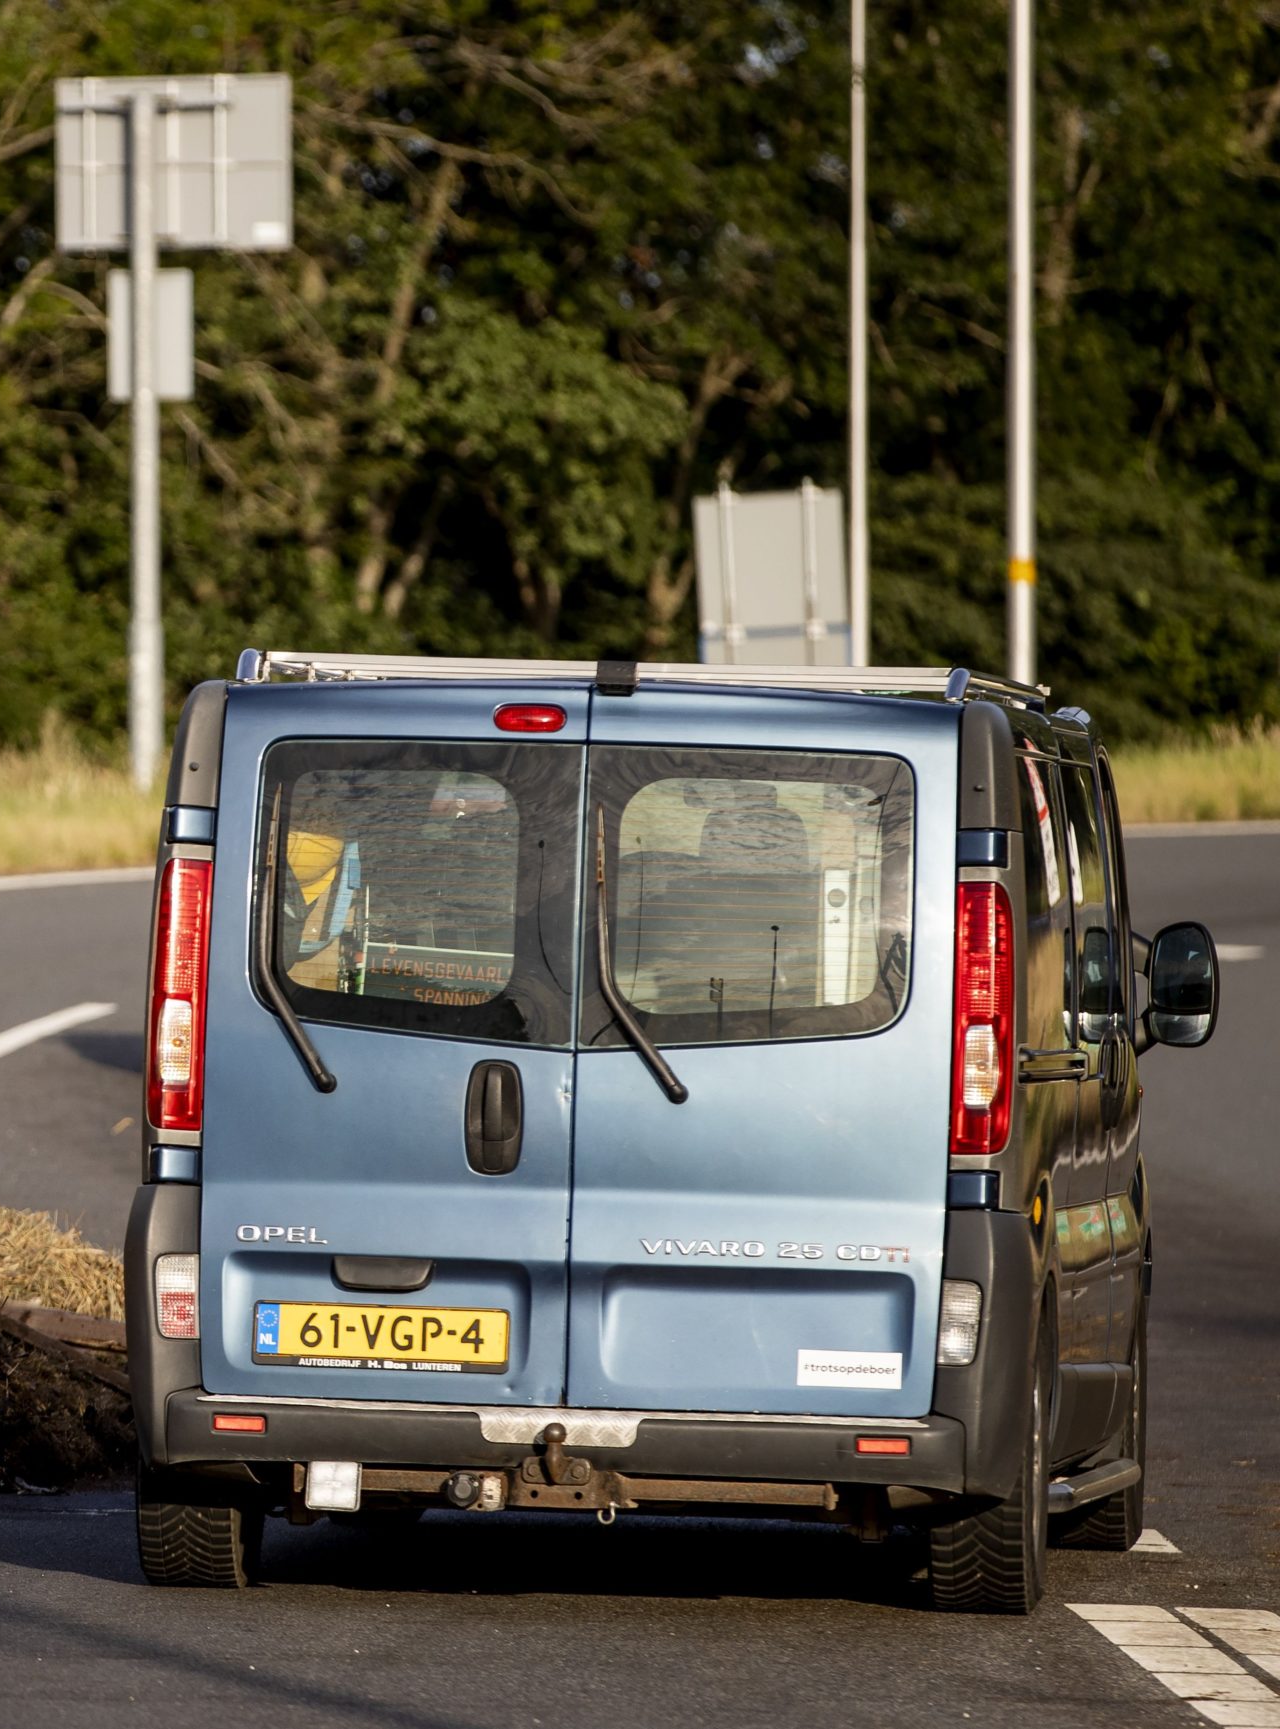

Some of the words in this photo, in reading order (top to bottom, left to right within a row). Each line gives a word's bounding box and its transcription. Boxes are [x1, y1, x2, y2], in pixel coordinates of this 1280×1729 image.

[236, 1224, 328, 1245] OPEL
[639, 1238, 766, 1258] VIVARO
[776, 1242, 824, 1260] 25
[836, 1244, 911, 1263] CDTI
[260, 1333, 276, 1346] NL
[299, 1312, 485, 1354] 61-VGP-4
[298, 1357, 362, 1368] AUTOBEDRIJF
[367, 1360, 382, 1369] H.
[383, 1361, 408, 1370] Bos
[412, 1362, 462, 1372] LUNTEREN
[803, 1362, 897, 1376] #trotsopdeboer
